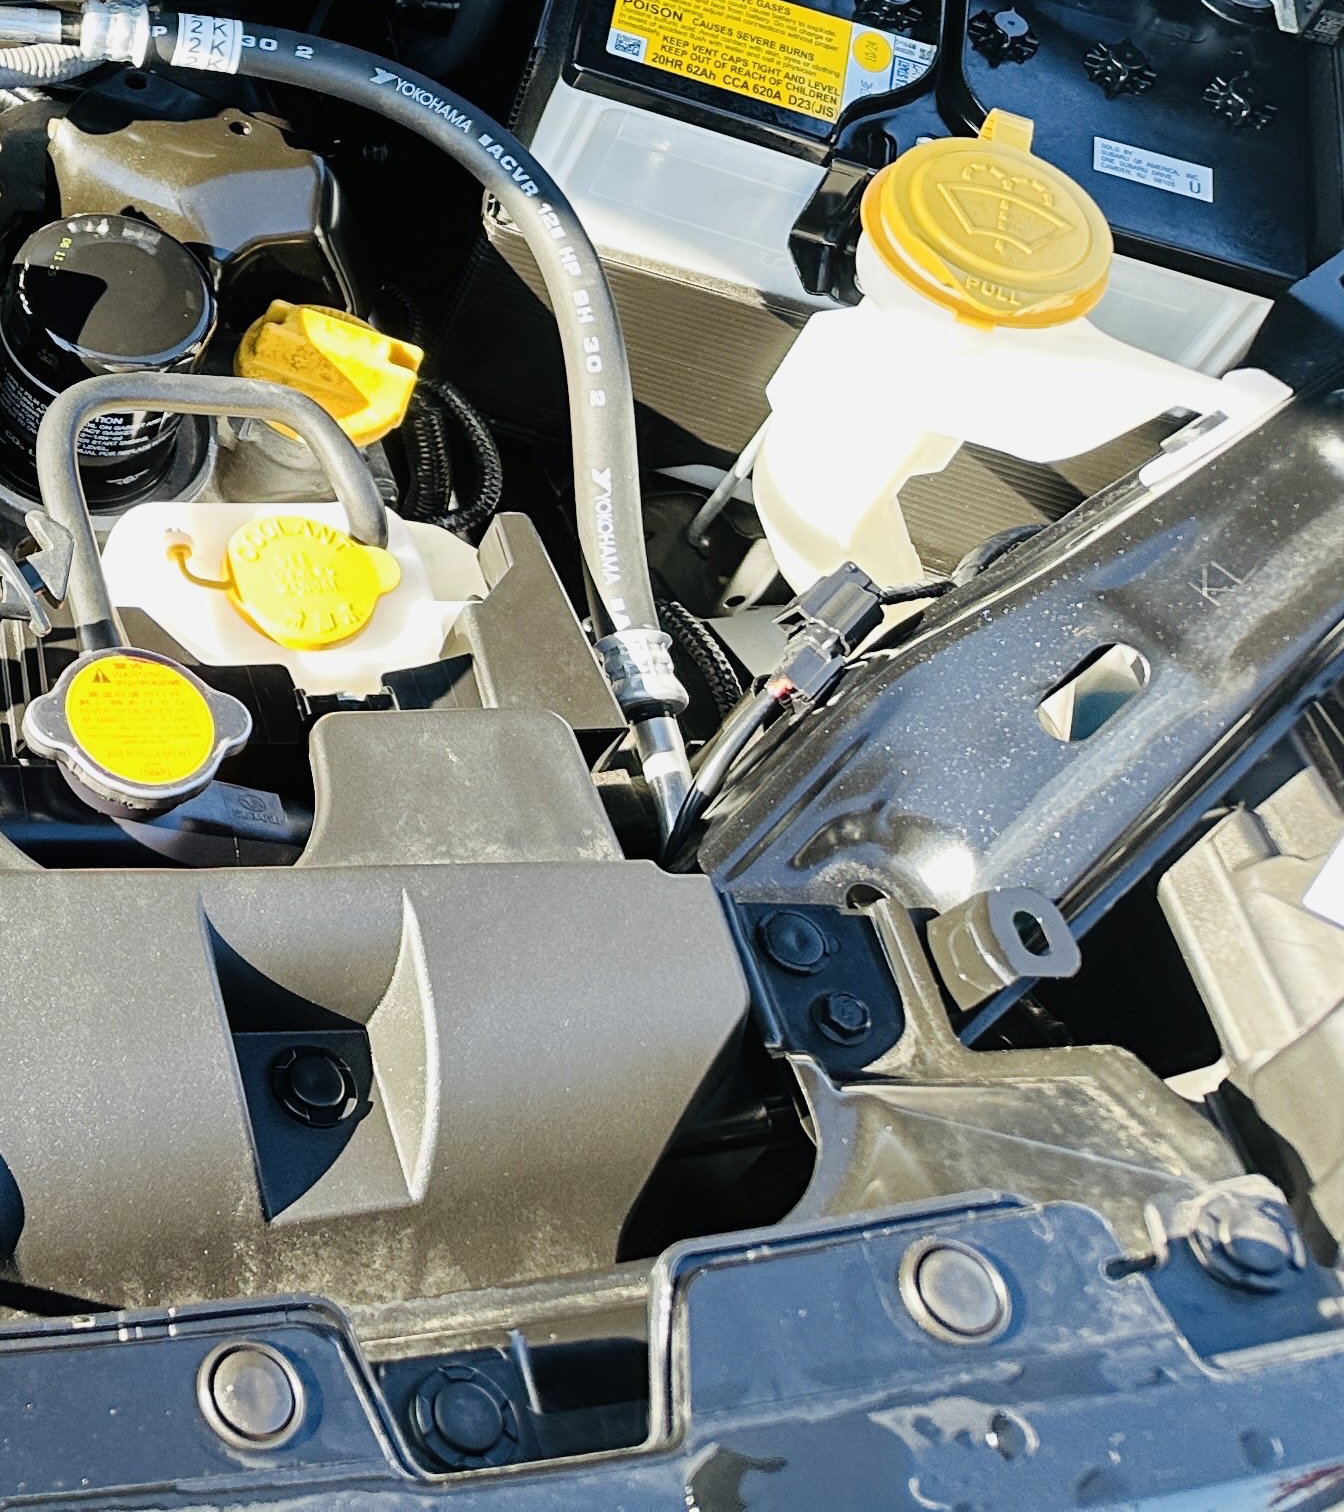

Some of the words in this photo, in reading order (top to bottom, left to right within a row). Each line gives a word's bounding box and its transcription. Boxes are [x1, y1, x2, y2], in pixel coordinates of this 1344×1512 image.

[188, 36, 202, 53] 2
[210, 38, 226, 56] K
[189, 19, 204, 34] 2
[211, 20, 228, 38] K
[692, 16, 733, 37] CAUSES
[736, 29, 776, 50] SEVERE
[778, 42, 815, 61] BURNS
[660, 42, 687, 58] KEEP
[689, 51, 710, 65] OUT
[713, 59, 727, 71] OF
[730, 64, 765, 83] REACH
[768, 75, 782, 88] OF
[784, 81, 837, 105] CHILDREN
[662, 33, 689, 49] KEEP
[691, 43, 717, 58] VENT
[720, 51, 748, 68] CAPS
[751, 61, 780, 77] TIGHT
[784, 71, 805, 85] AND
[807, 79, 841, 97] LEVEL
[293, 44, 315, 60] 2
[394, 76, 473, 135] YOKOHAMA
[651, 51, 683, 71] 20HR
[685, 62, 716, 81] 62Ah
[722, 73, 750, 91] CCA
[752, 83, 782, 102] 620A
[787, 93, 838, 121] D23(JIS)
[1101, 148, 1129, 162] SUBARU
[1189, 179, 1200, 195] U
[964, 276, 1024, 306] PULL
